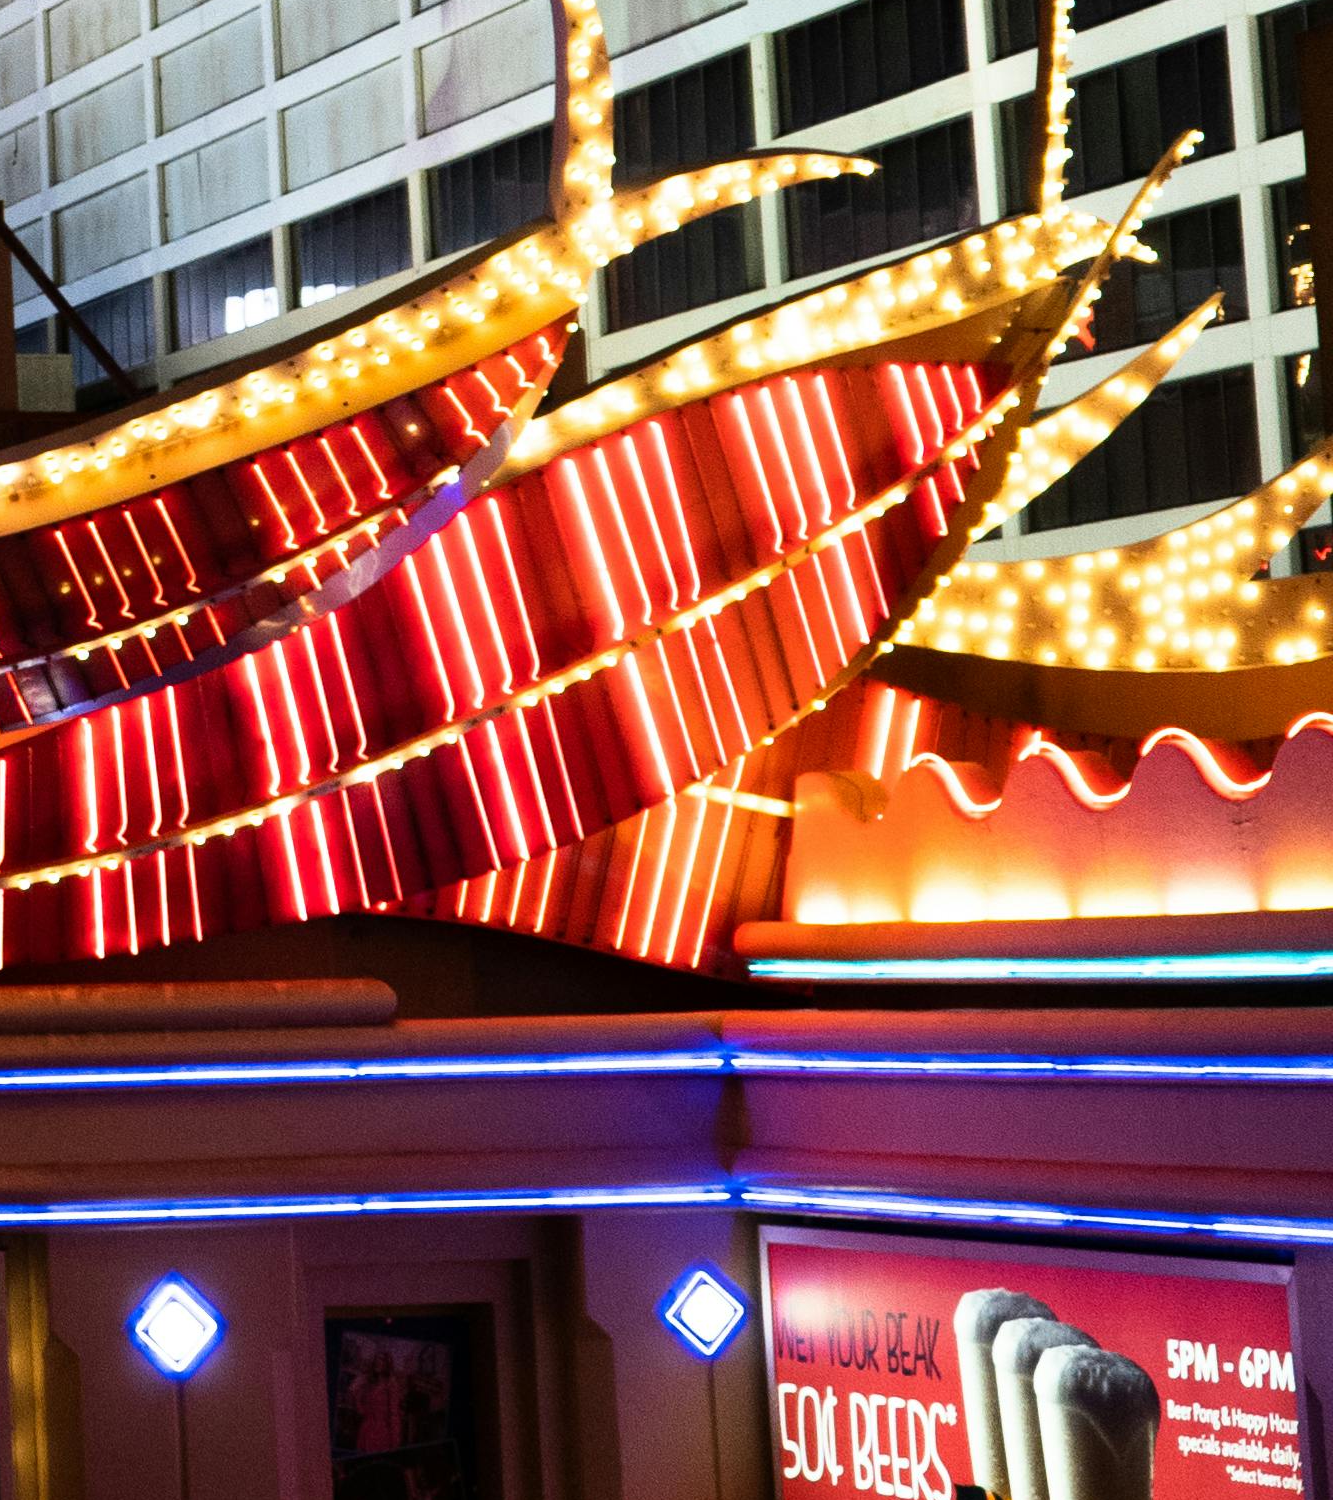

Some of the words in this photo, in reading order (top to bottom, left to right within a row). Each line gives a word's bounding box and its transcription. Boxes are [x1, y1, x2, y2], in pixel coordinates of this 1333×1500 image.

[885, 1311, 942, 1381] BEAK
[1166, 1338, 1220, 1384] 5PM
[1222, 1361, 1235, 1373] -
[1238, 1345, 1297, 1392] 6PM
[777, 1382, 844, 1487] 50¢
[1166, 1398, 1193, 1421] Beer
[1192, 1402, 1221, 1431] Pong
[1220, 1405, 1232, 1427] &
[1231, 1407, 1269, 1437] Happy
[1269, 1412, 1299, 1435] Hour
[1177, 1433, 1221, 1457] specials
[1221, 1438, 1271, 1463] available
